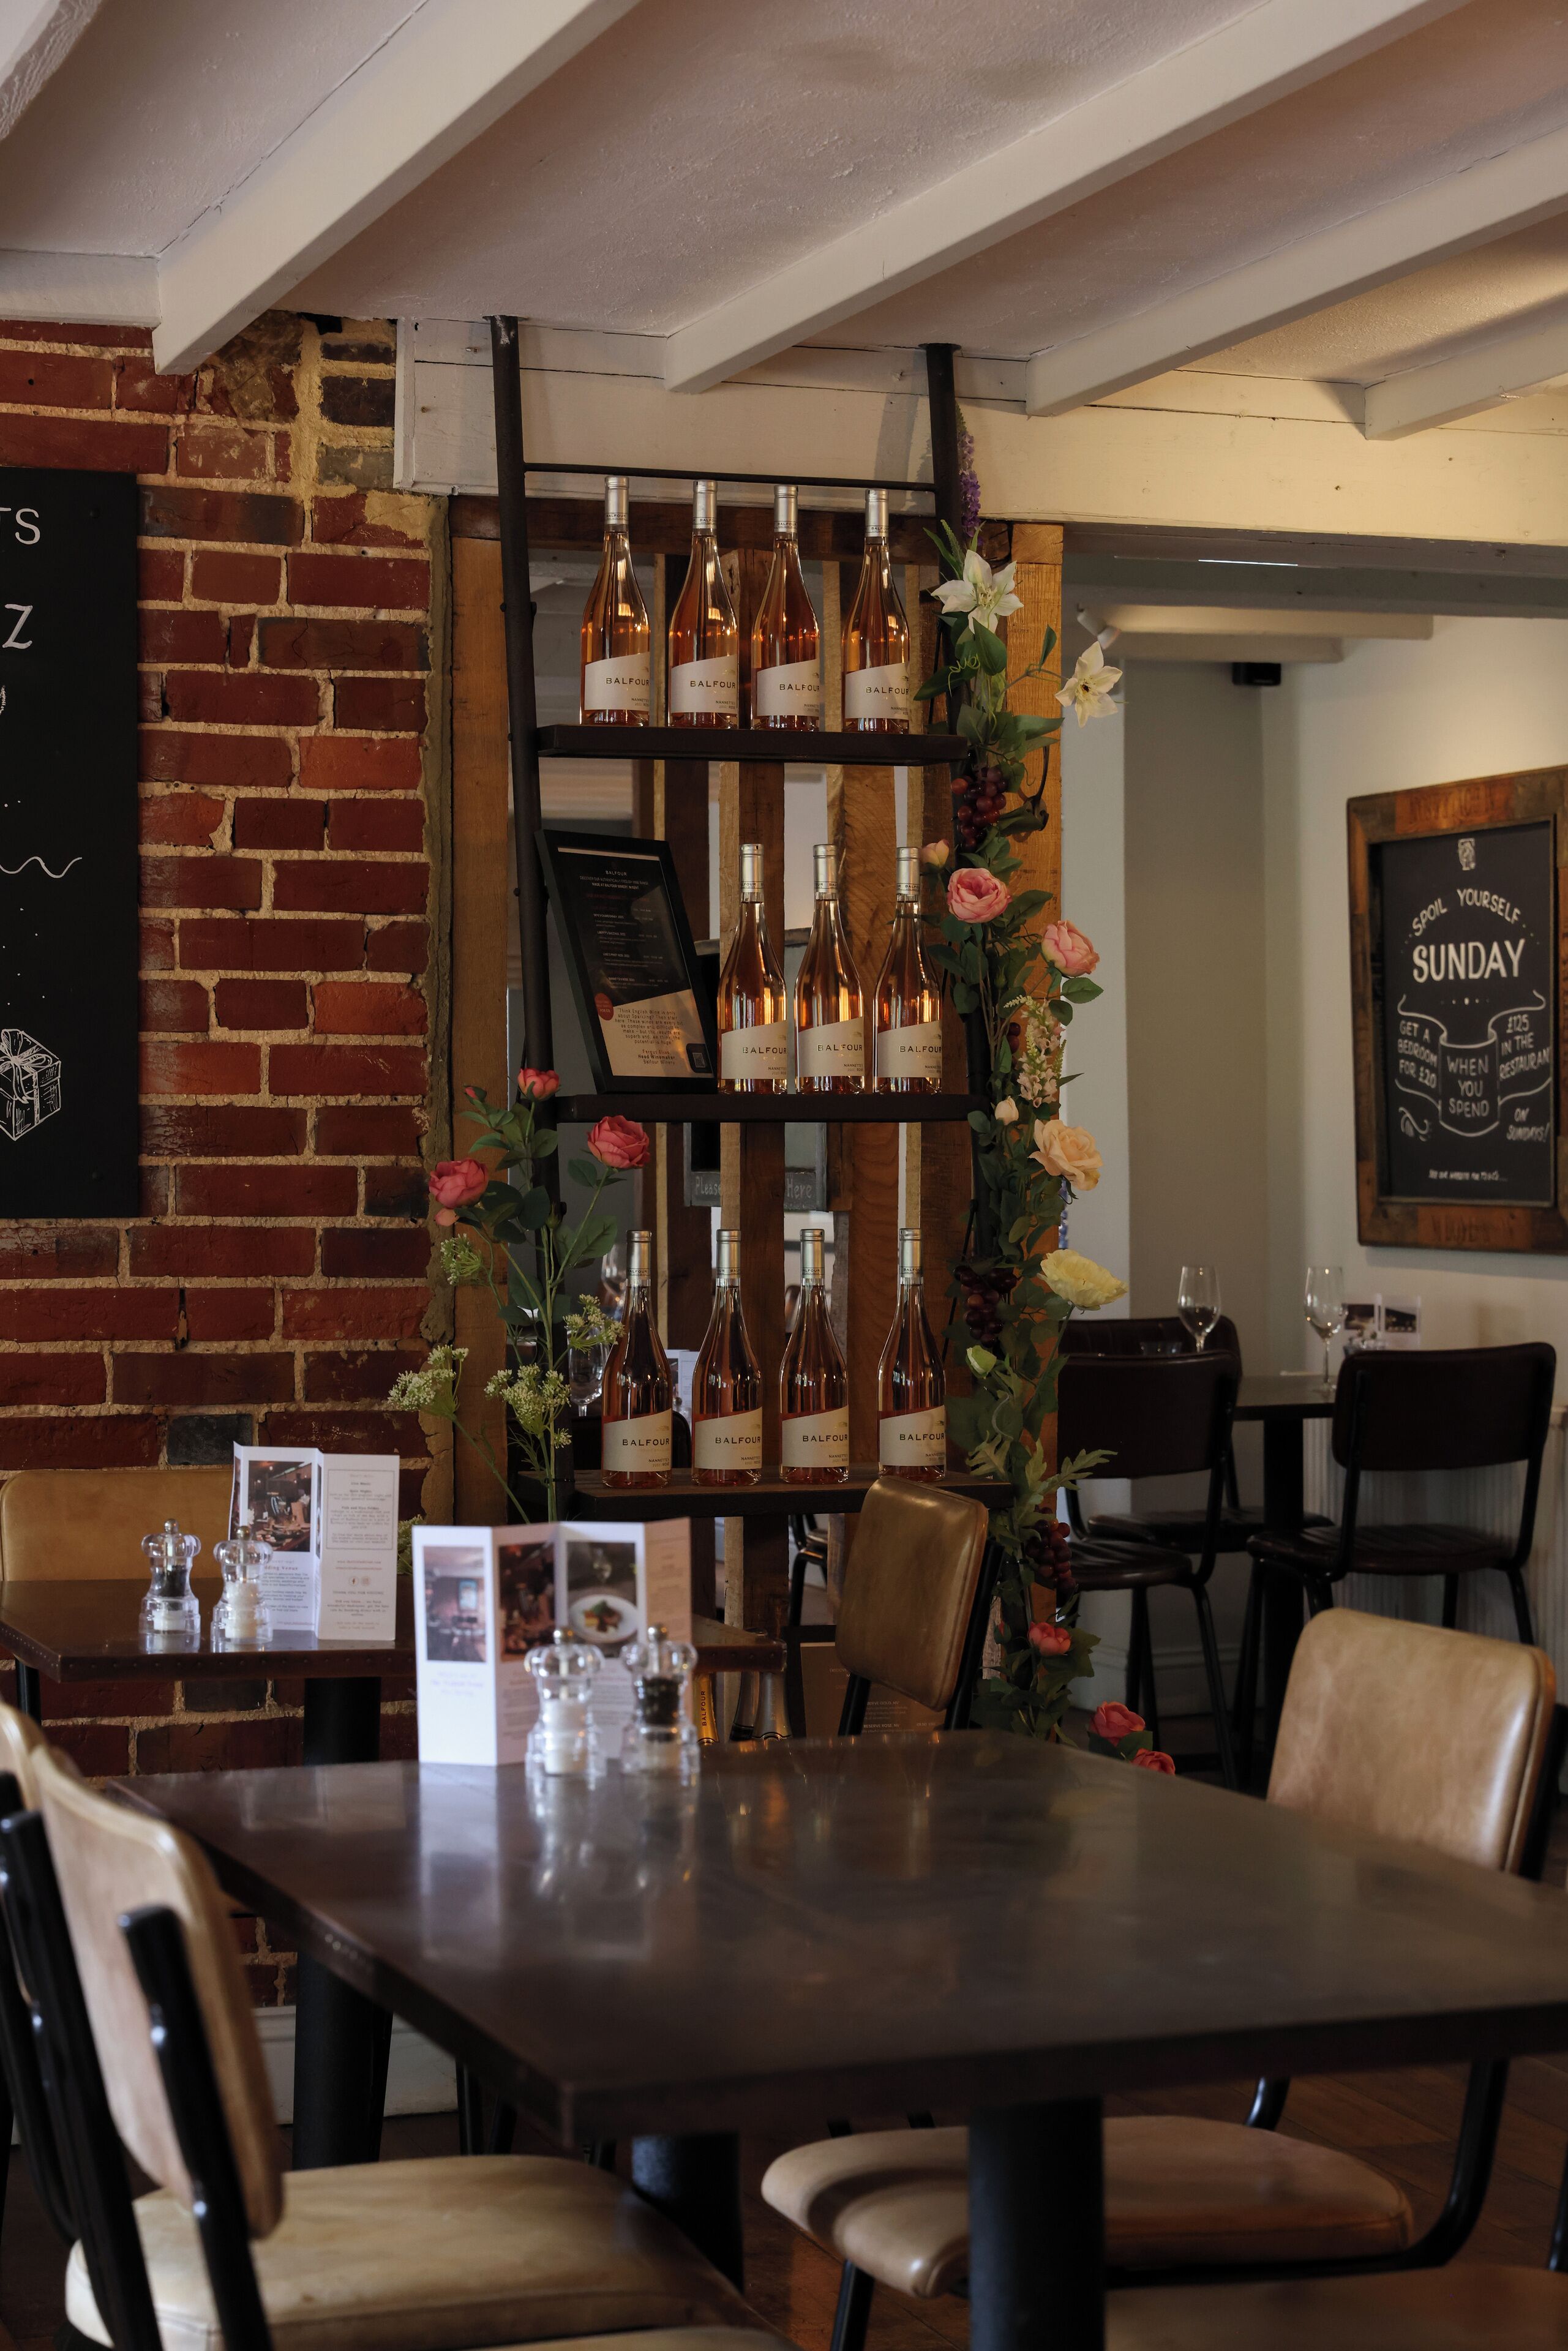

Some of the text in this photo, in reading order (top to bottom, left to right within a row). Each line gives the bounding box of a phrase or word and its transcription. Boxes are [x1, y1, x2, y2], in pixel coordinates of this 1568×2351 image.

[606, 677, 650, 686] BALFOUR
[690, 680, 735, 689] BALFOUR
[866, 686, 909, 695] BALFOUR
[1411, 888, 1521, 937] SPOIL YOURSELF
[1412, 938, 1526, 983] SUNDAY
[1398, 1019, 1431, 1044] GET A
[1506, 1014, 1530, 1034] £125
[1397, 1038, 1438, 1068] BEDROOM
[1501, 1031, 1535, 1057] IN THE
[1398, 1059, 1437, 1089] FOR £20
[1446, 1054, 1490, 1077] WHEN
[1498, 1046, 1550, 1082] RESTAURAN
[1458, 1079, 1484, 1098] YOU
[1448, 1097, 1490, 1119] SPEND
[1514, 1107, 1529, 1123] ON
[1506, 1122, 1550, 1143] SUNDAYS!
[786, 1177, 812, 1199] Here
[622, 1438, 670, 1446] BALFOUR
[715, 1436, 760, 1444] BALFOUR
